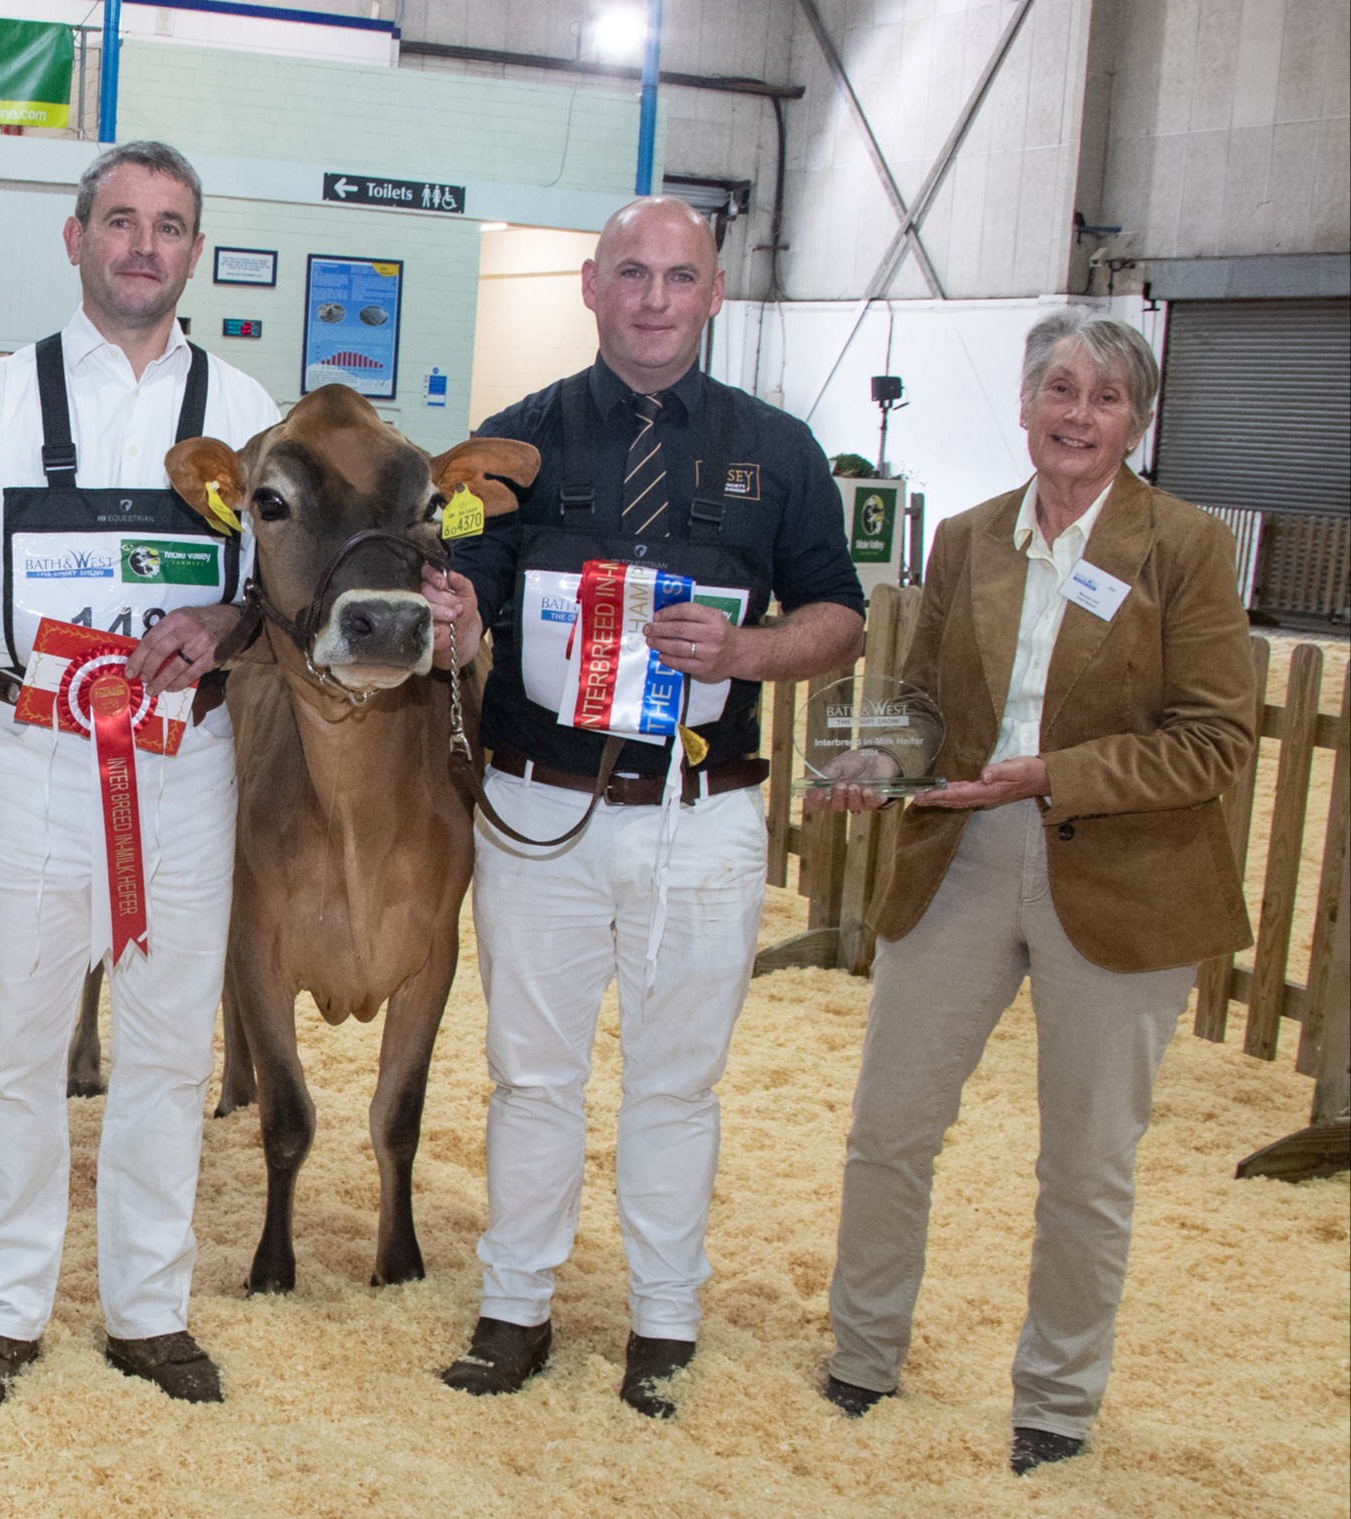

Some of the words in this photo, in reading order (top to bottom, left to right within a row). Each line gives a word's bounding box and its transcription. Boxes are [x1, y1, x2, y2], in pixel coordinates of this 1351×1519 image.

[366, 182, 413, 200] Toilets
[727, 469, 754, 492] SEY
[108, 514, 155, 523] EQUESTRIAN
[551, 612, 566, 620] THE
[580, 603, 615, 729] NTERBREED
[646, 683, 673, 733] THE
[863, 737, 894, 746] In-Milk
[896, 737, 924, 746] Heifer
[107, 757, 129, 792] INTER
[111, 793, 133, 832] BREED
[114, 833, 135, 875] IN-MILK
[117, 875, 139, 917] HEIFER
